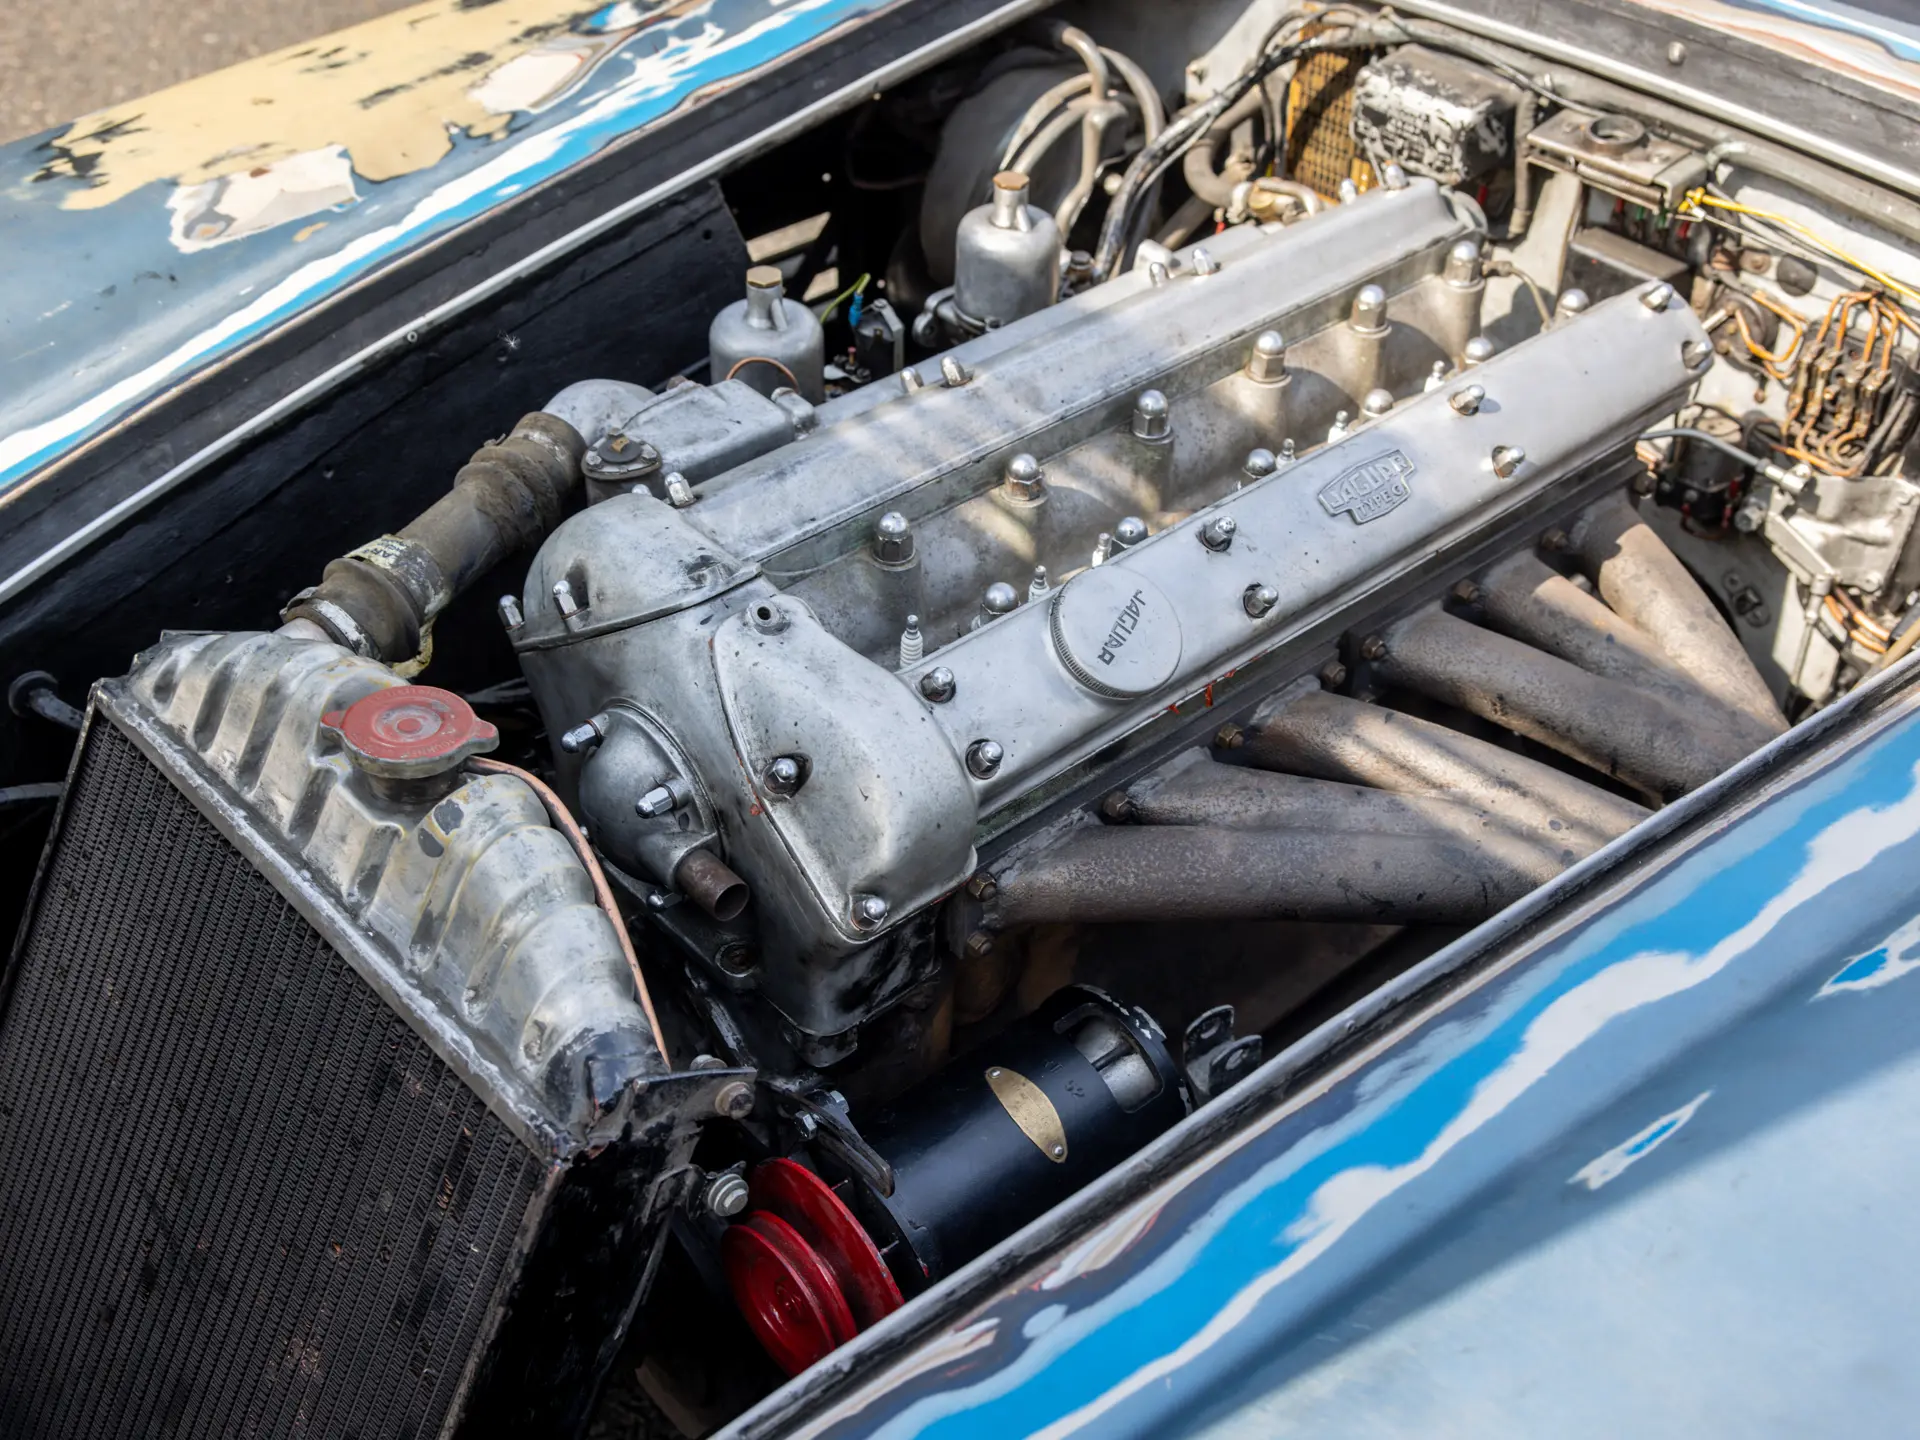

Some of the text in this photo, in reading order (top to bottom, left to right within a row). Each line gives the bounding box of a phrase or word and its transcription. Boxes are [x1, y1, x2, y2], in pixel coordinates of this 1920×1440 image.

[1330, 456, 1408, 509] JAGUAR
[1356, 484, 1402, 517] TYPE C
[1097, 589, 1146, 666] JAGUAR
